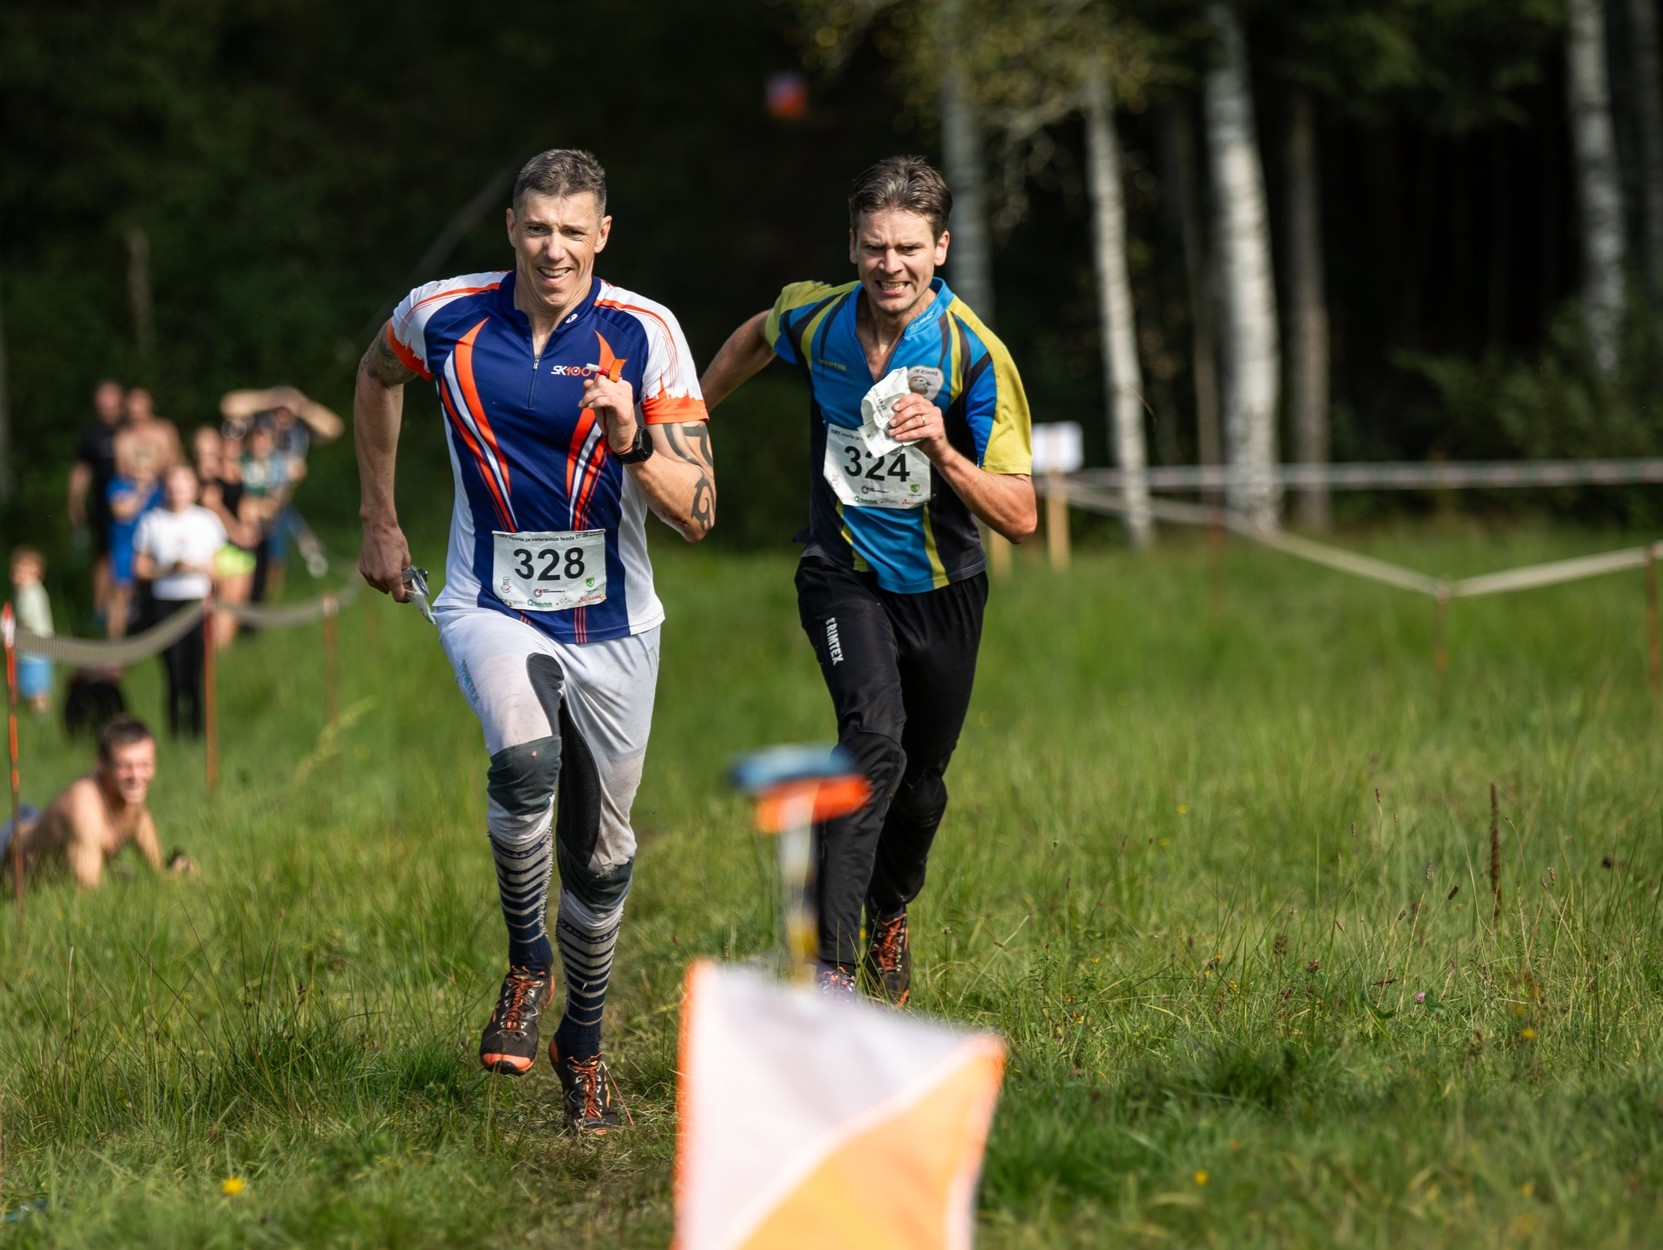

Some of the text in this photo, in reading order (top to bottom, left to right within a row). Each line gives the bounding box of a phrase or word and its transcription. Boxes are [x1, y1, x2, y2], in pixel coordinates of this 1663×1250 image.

[551, 366, 592, 377] SK100
[844, 446, 910, 482] 324
[513, 547, 585, 581] 328
[825, 617, 844, 666] TRIMTEX
